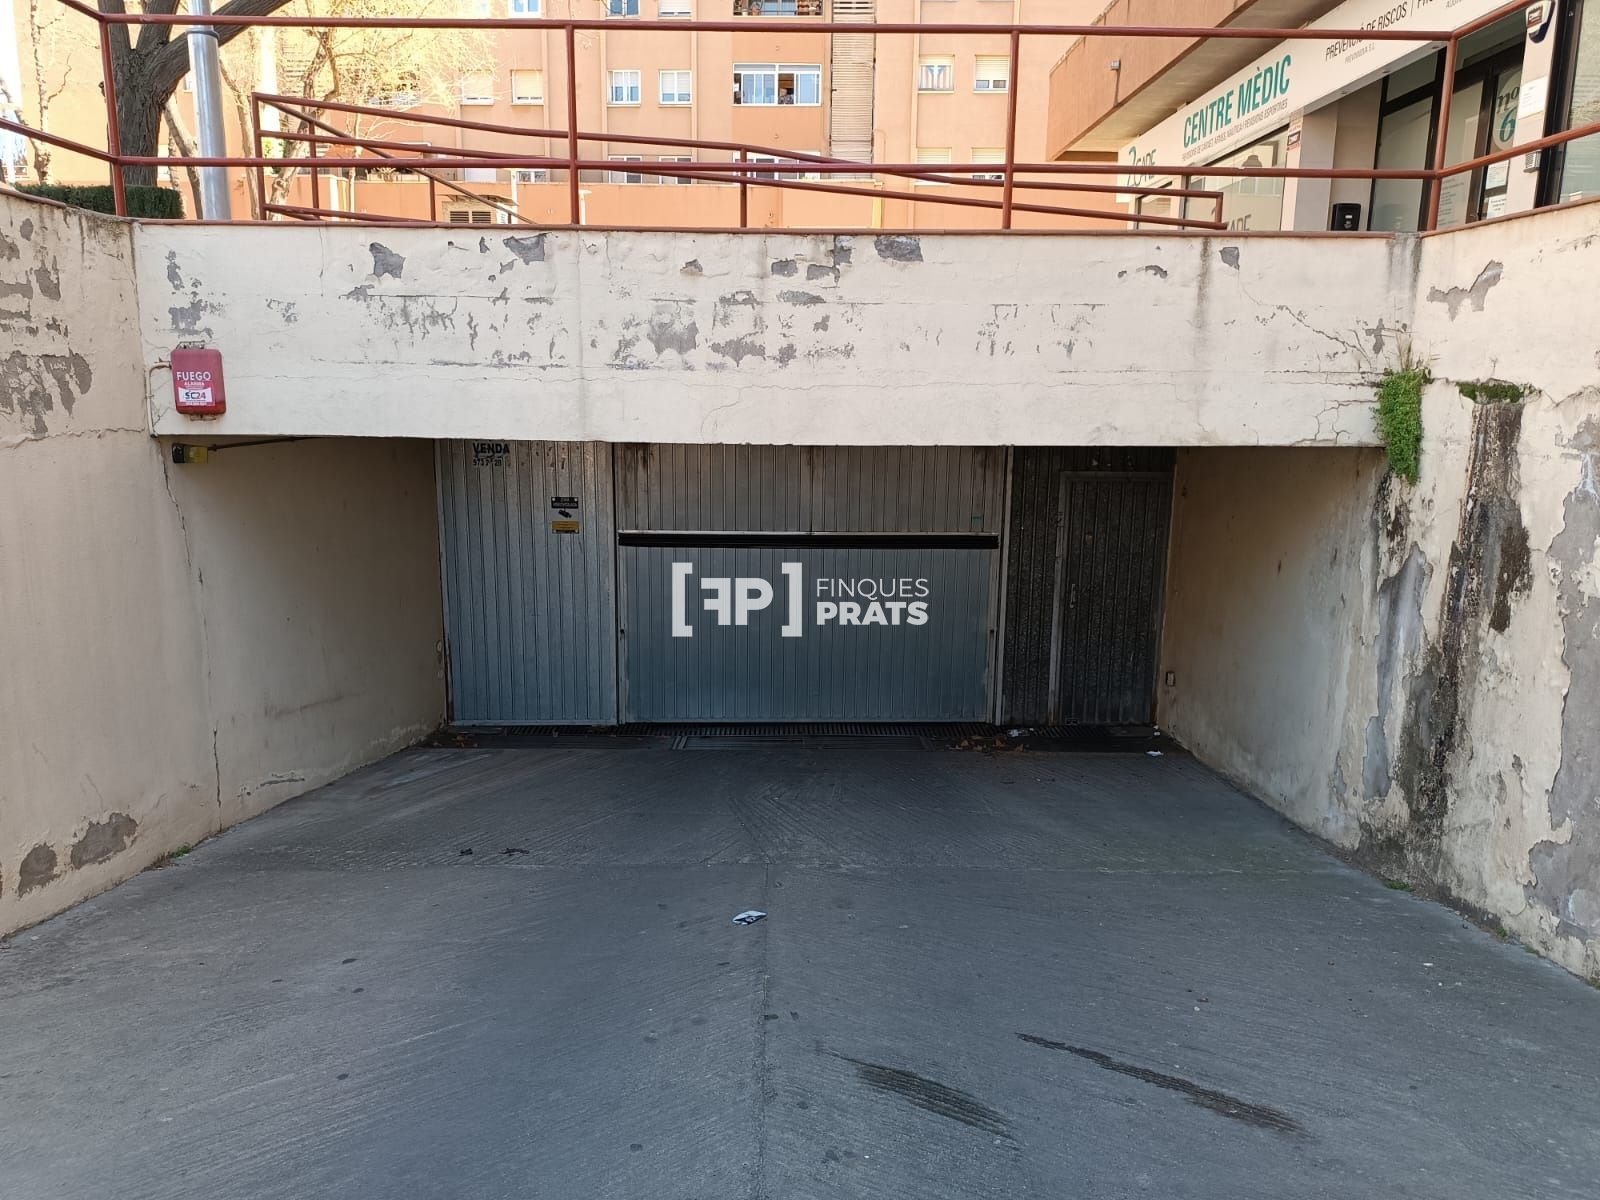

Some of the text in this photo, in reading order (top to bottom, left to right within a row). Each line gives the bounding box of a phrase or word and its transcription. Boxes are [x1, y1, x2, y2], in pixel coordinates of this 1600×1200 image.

[1377, 2, 1408, 31] RISCOS
[1184, 54, 1291, 148] CENTRE MÈDIC
[1500, 105, 1517, 142] 6
[176, 371, 211, 381] FUEGO
[472, 442, 510, 454] VENDA
